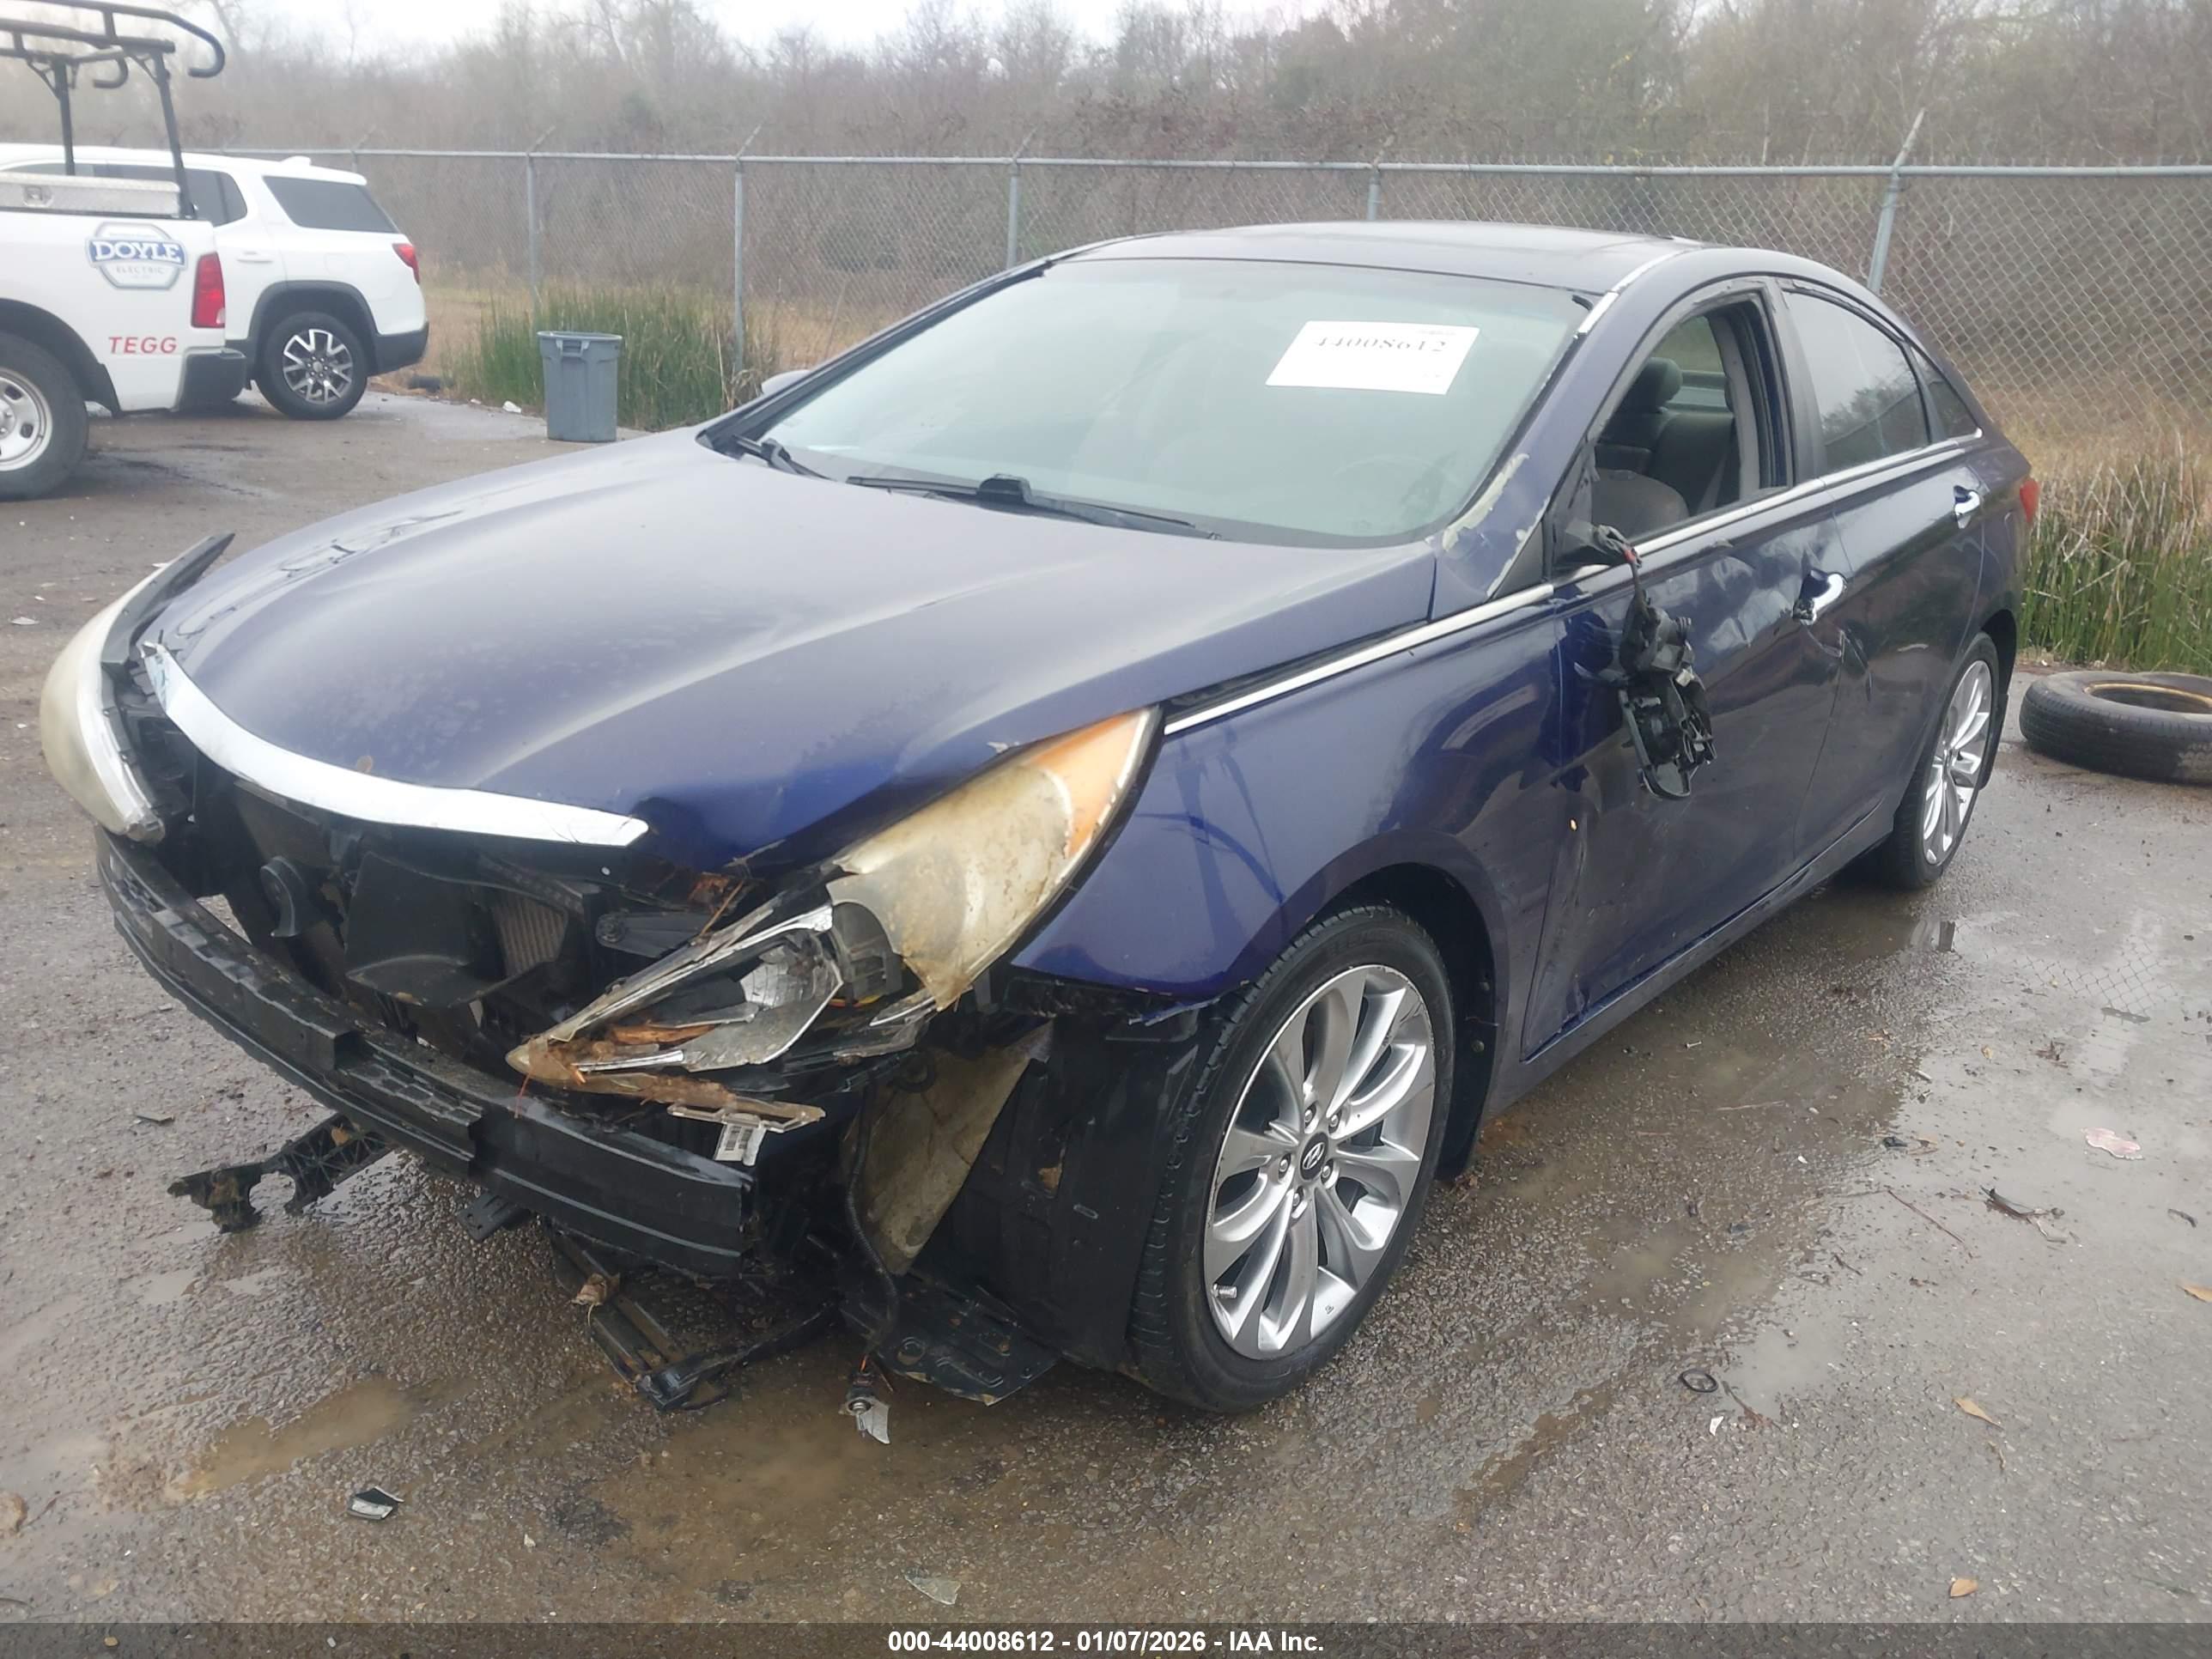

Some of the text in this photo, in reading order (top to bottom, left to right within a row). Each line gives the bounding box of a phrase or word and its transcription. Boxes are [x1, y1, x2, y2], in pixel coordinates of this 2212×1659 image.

[92, 240, 181, 264] DOYLE
[116, 264, 165, 275] ELECTRIC
[108, 336, 178, 355] TEGG
